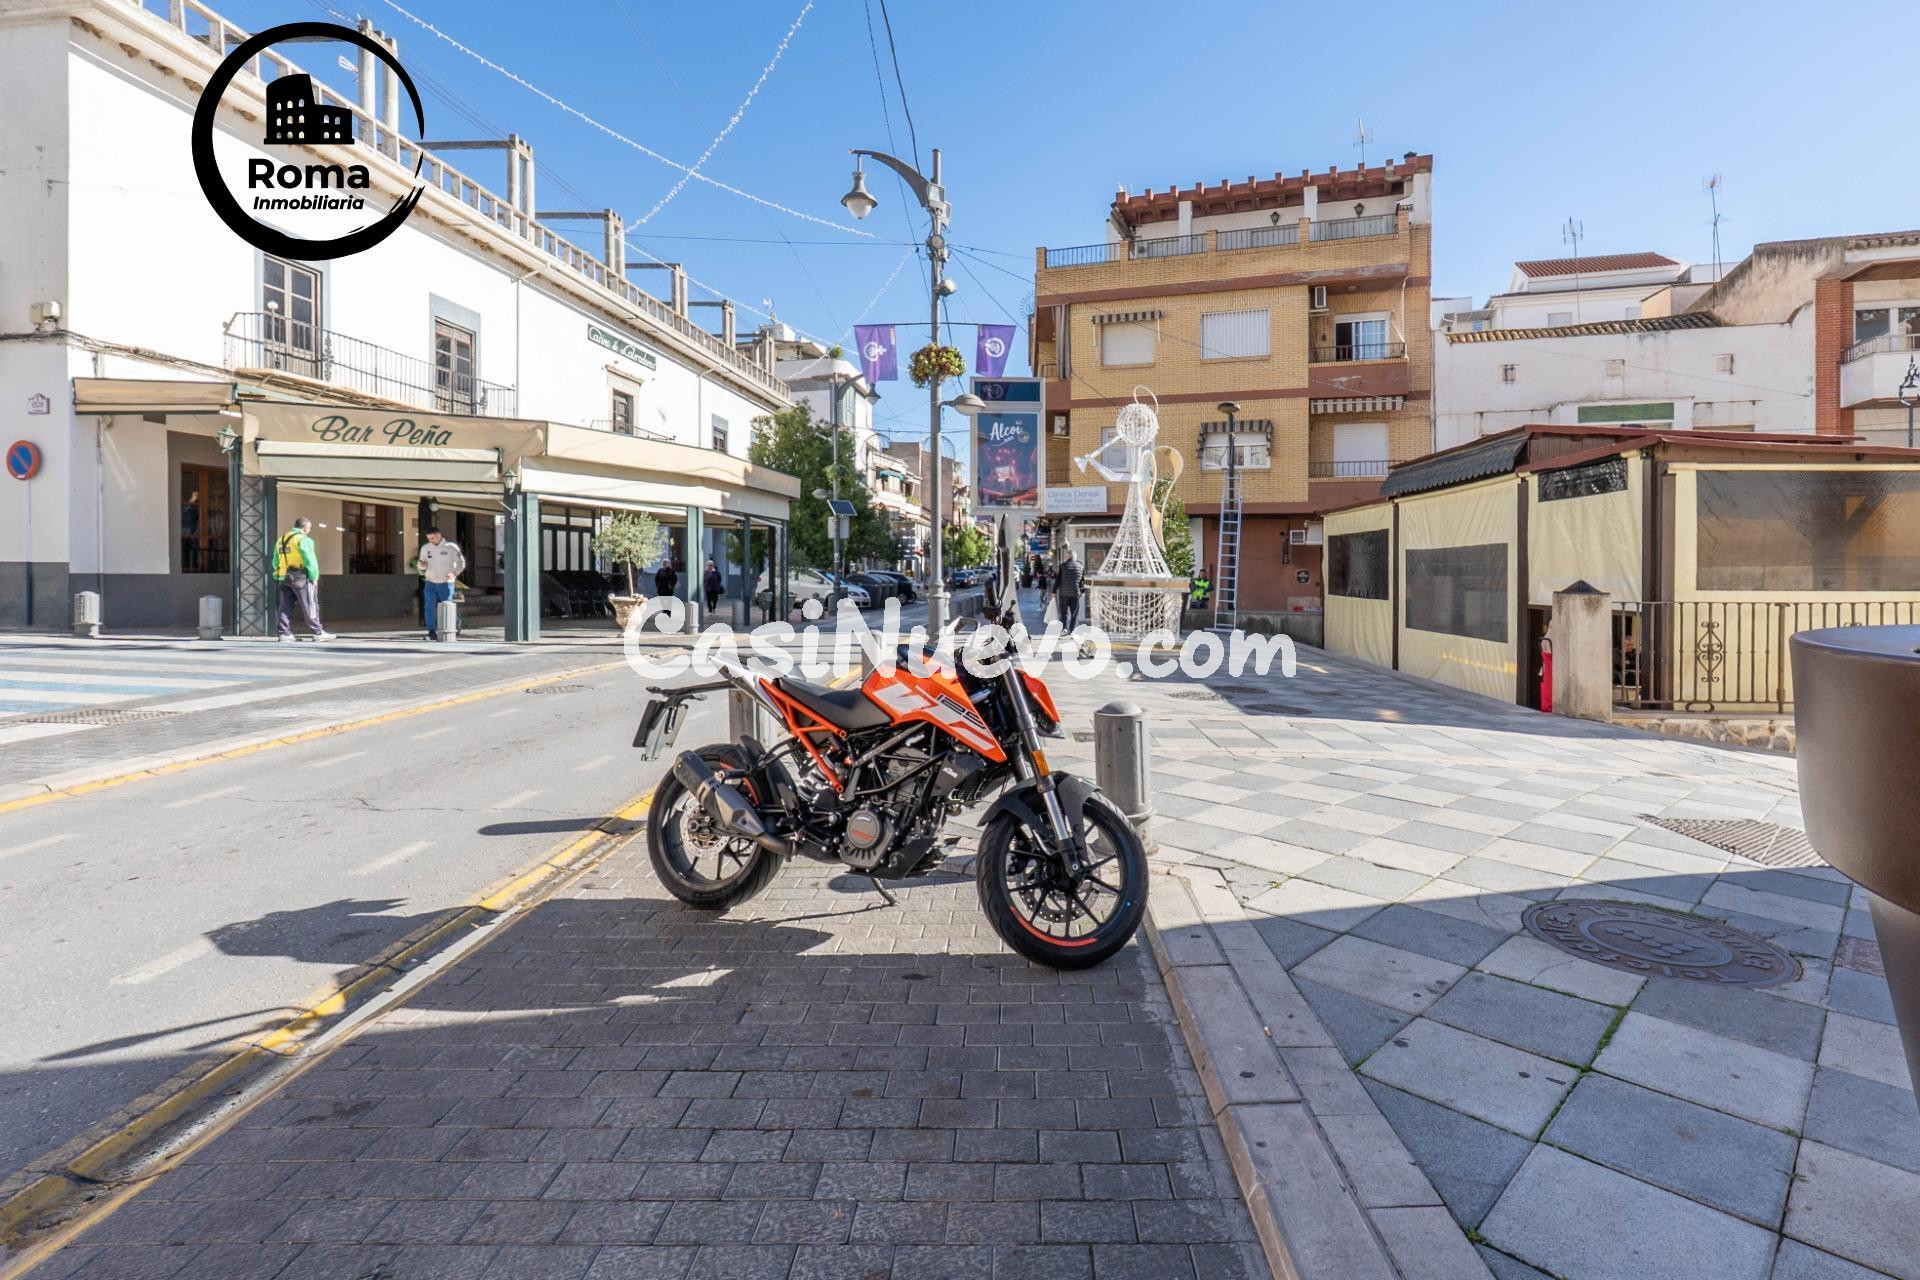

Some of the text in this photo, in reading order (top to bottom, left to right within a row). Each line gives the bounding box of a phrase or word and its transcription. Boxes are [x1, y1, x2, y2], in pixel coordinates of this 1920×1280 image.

[311, 415, 453, 447] Bar Peña
[937, 694, 986, 730] 125
